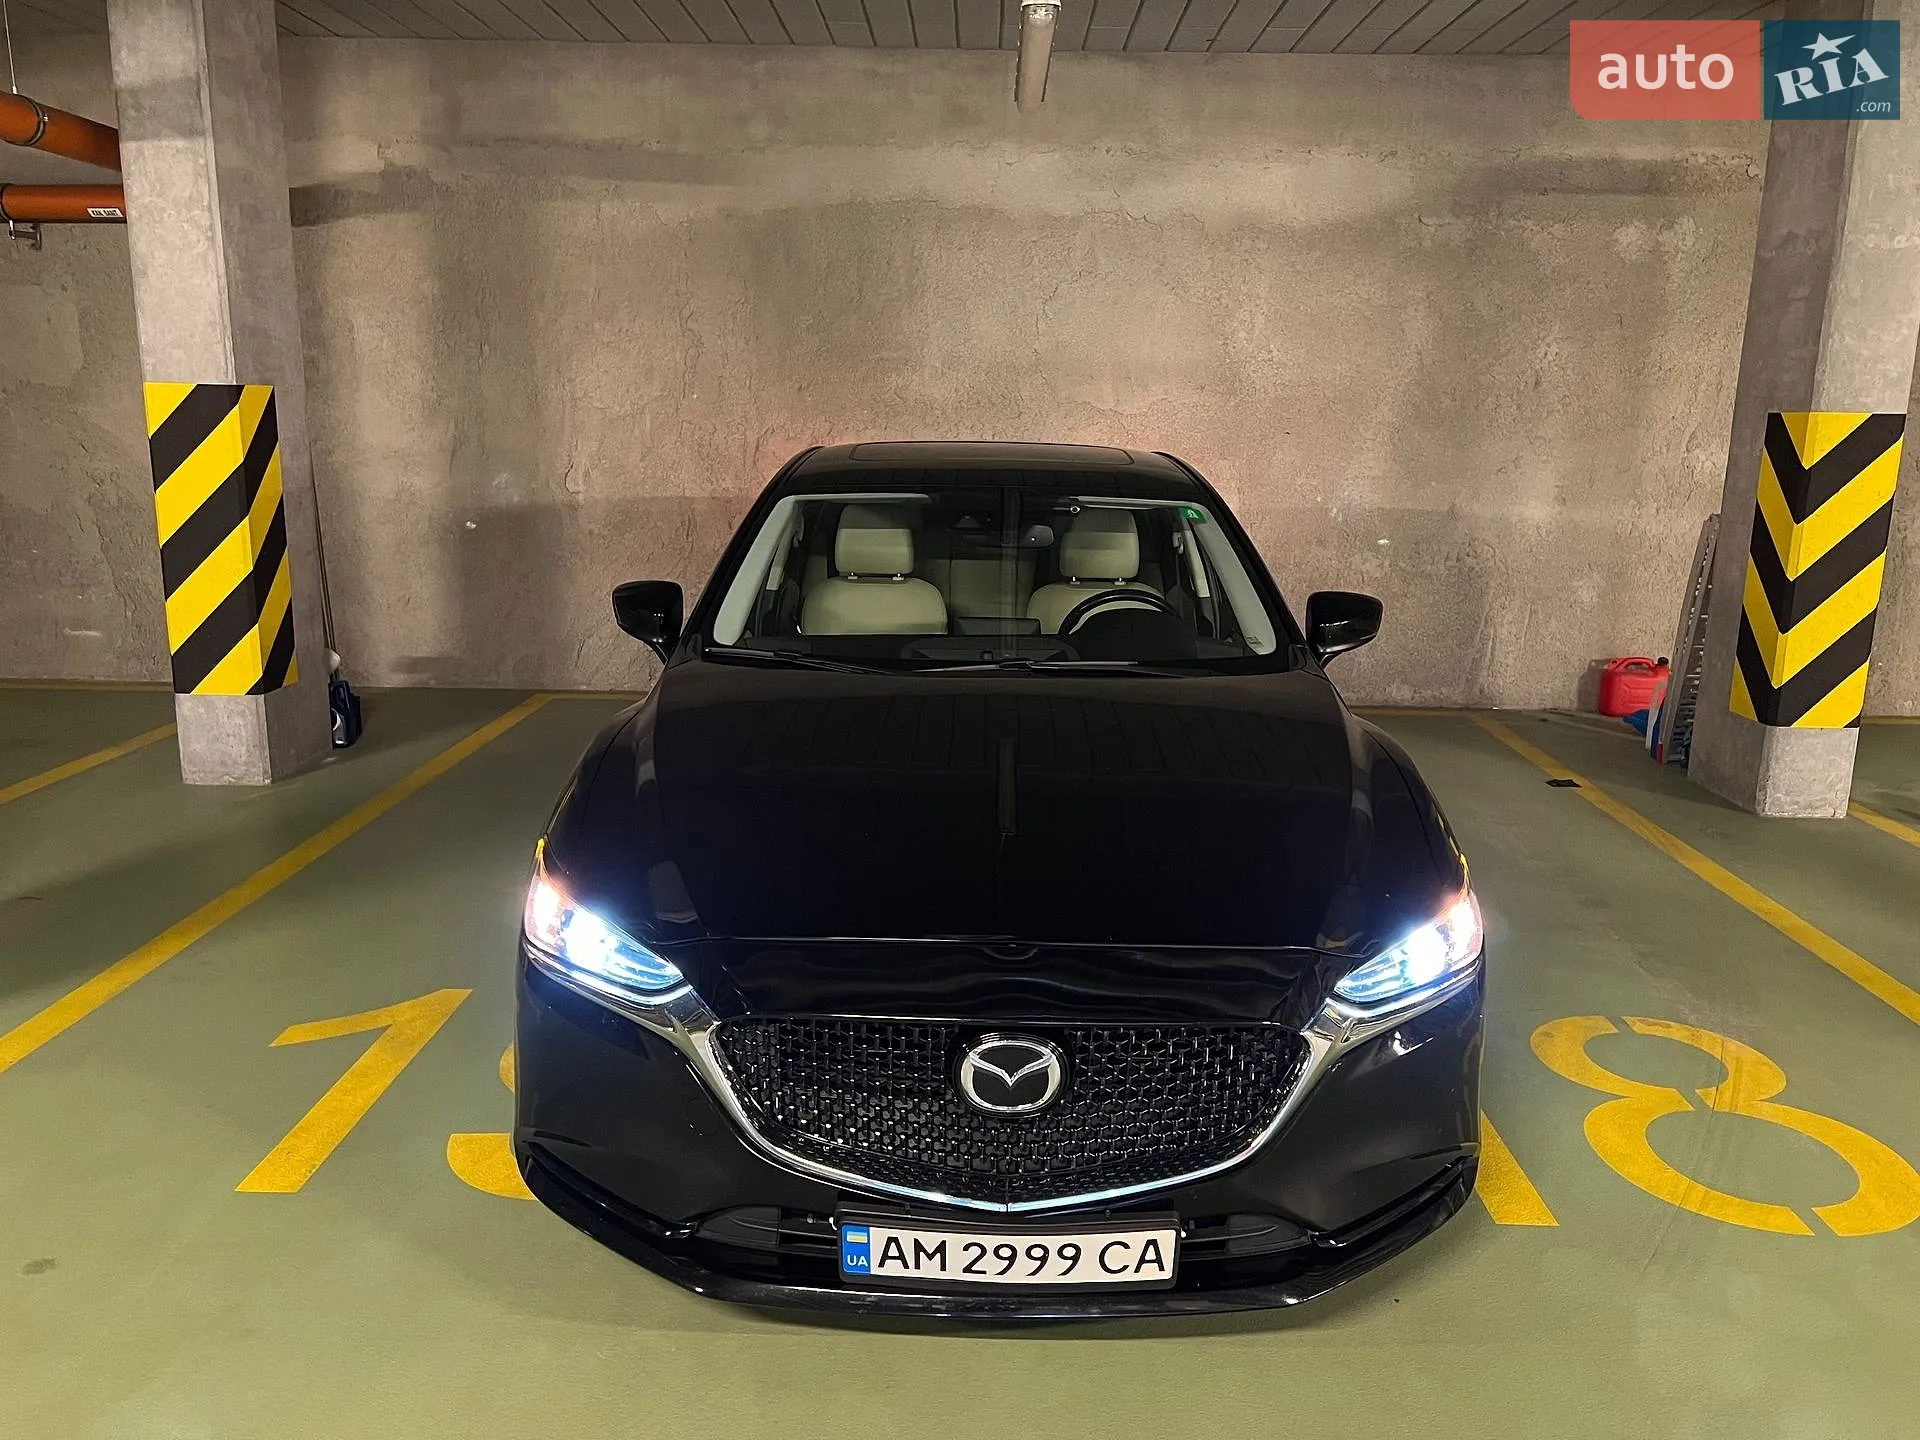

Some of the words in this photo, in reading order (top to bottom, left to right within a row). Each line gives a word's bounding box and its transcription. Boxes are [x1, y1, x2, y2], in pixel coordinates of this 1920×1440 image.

[847, 1254, 868, 1268] UA
[877, 1236, 947, 1272] AM
[961, 1241, 1082, 1277] 2999
[1098, 1238, 1166, 1275] CA
